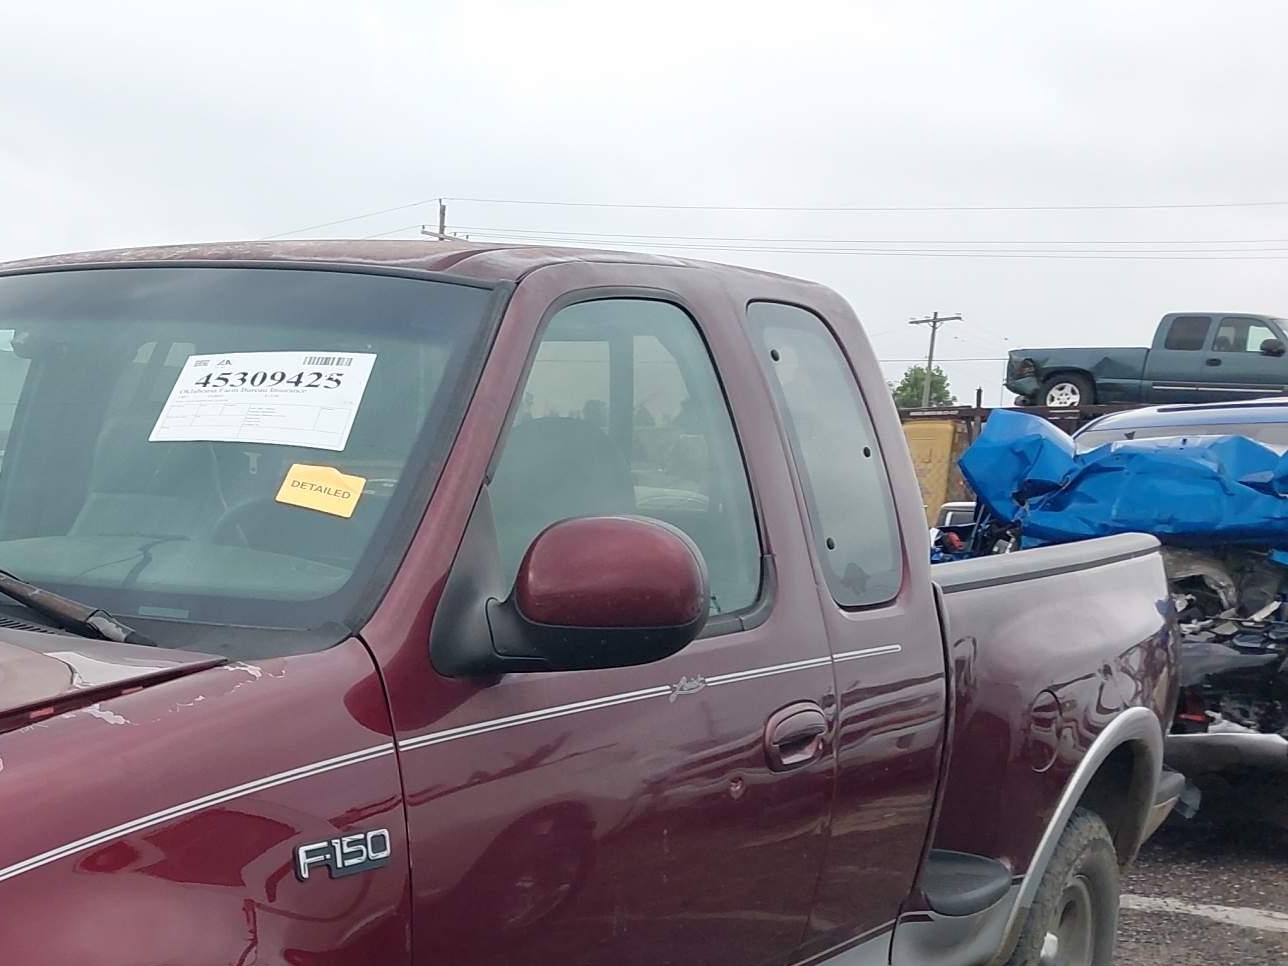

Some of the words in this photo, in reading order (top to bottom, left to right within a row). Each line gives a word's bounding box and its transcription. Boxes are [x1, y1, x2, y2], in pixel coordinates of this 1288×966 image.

[194, 370, 345, 390] 45309425
[290, 479, 352, 500] DETAILED
[298, 828, 391, 879] F-150
